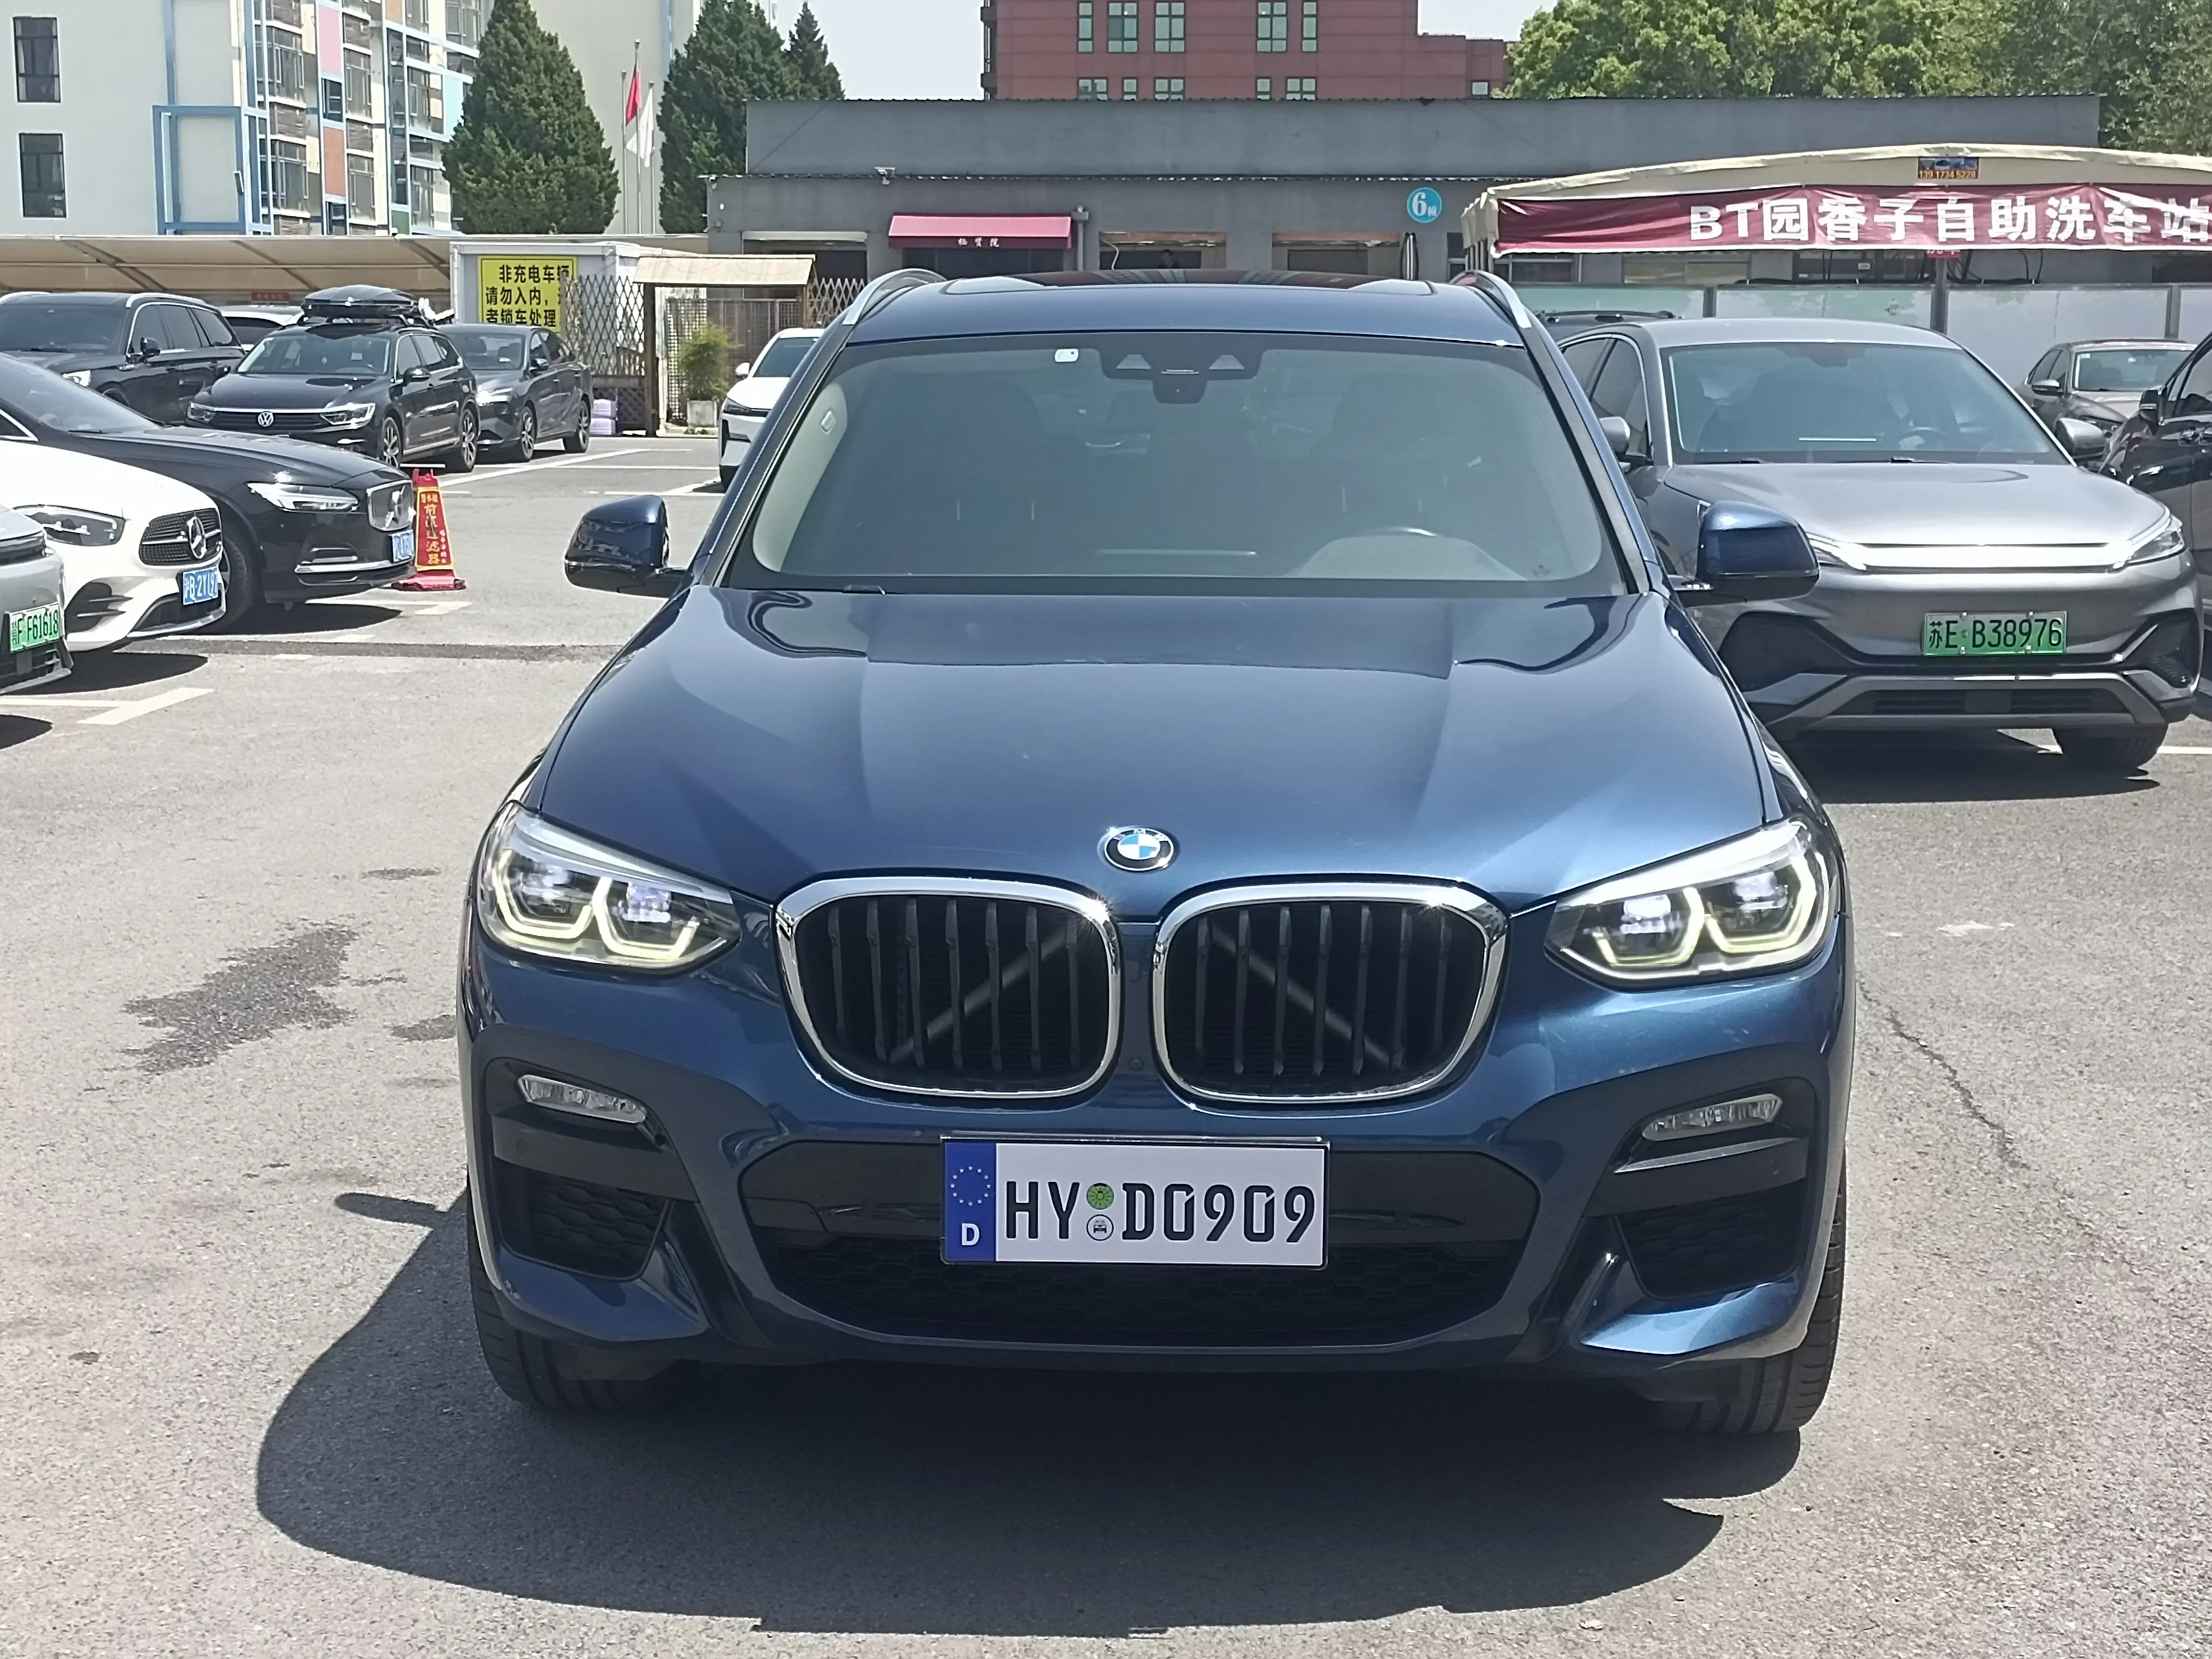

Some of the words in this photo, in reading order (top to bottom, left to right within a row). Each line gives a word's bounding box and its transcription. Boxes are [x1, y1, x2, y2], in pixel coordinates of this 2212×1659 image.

[1690, 195, 2209, 242] BT园香子自助洗车站
[486, 287, 561, 305] 请勿入内，
[1006, 1181, 1080, 1239] HY
[961, 1223, 980, 1246] D
